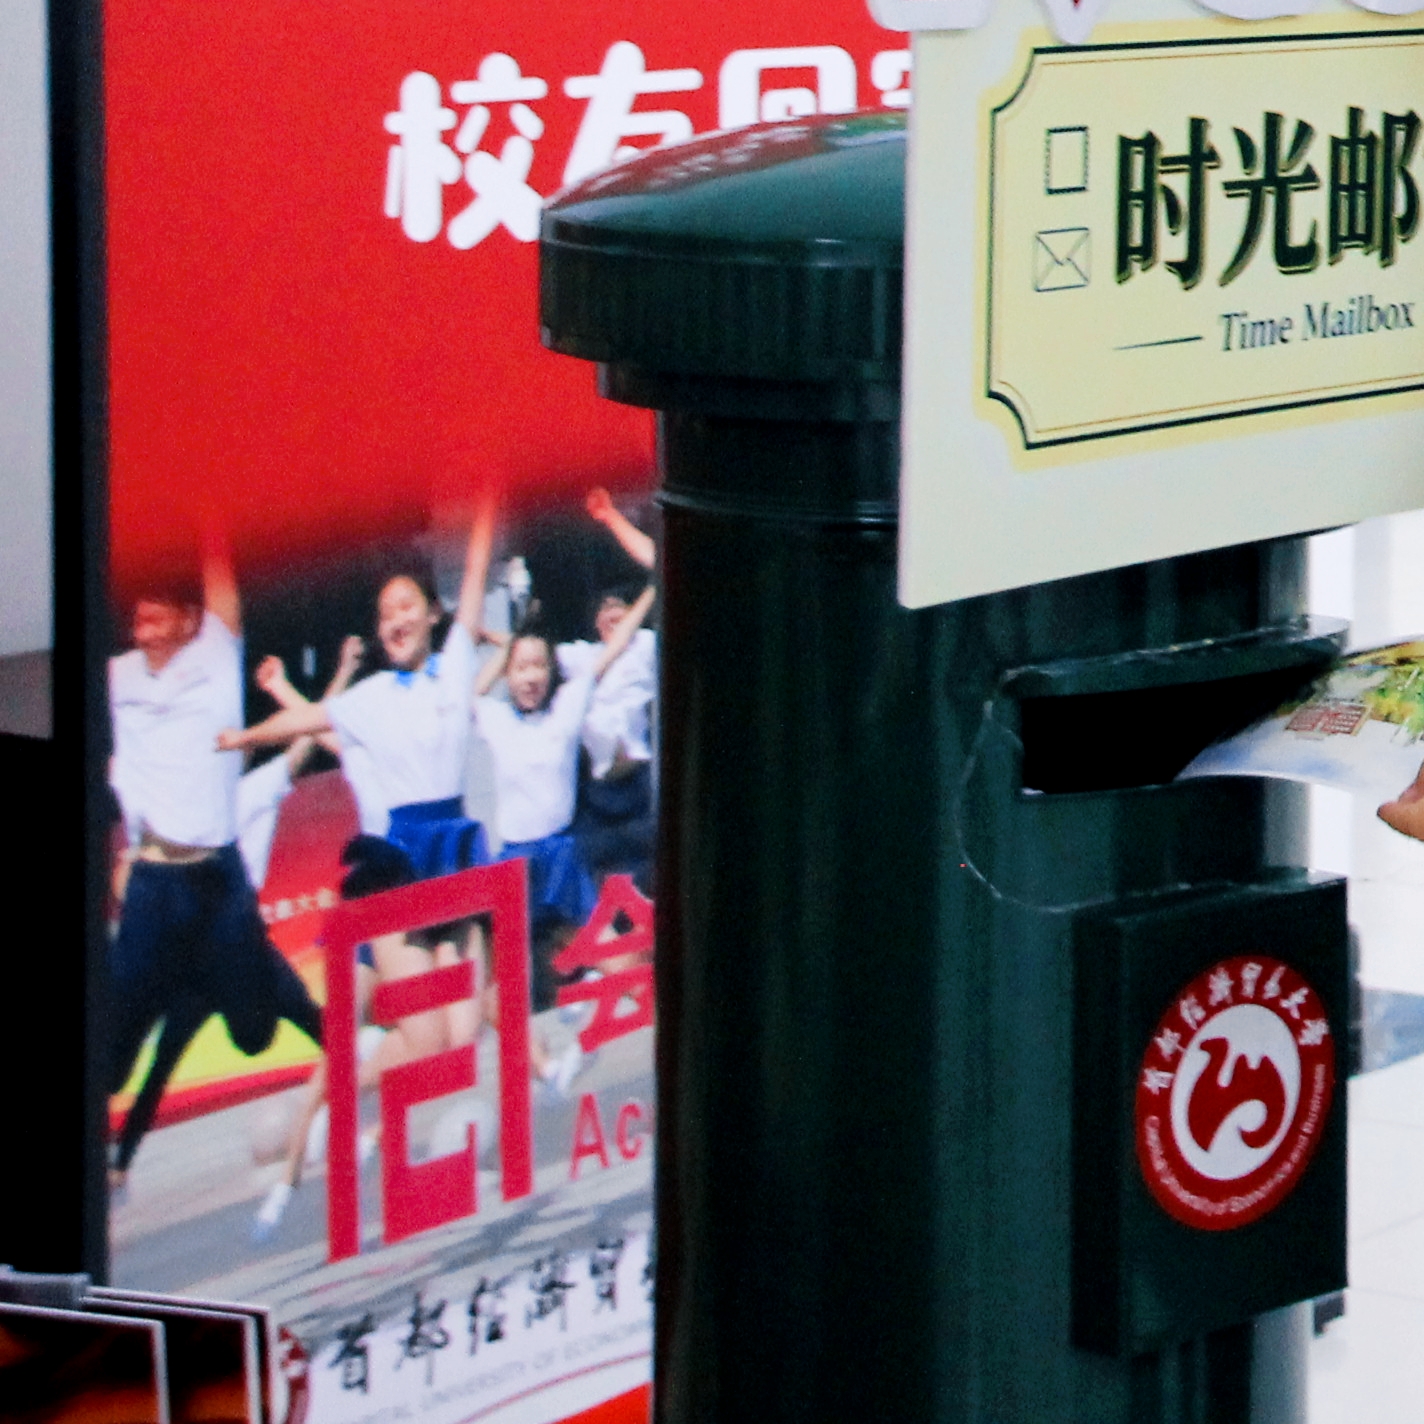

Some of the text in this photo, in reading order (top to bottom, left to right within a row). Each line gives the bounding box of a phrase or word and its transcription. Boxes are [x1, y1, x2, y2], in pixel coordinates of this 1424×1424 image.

[1220, 293, 1416, 353] Time Mailbox
[569, 1092, 653, 1181] Ac
